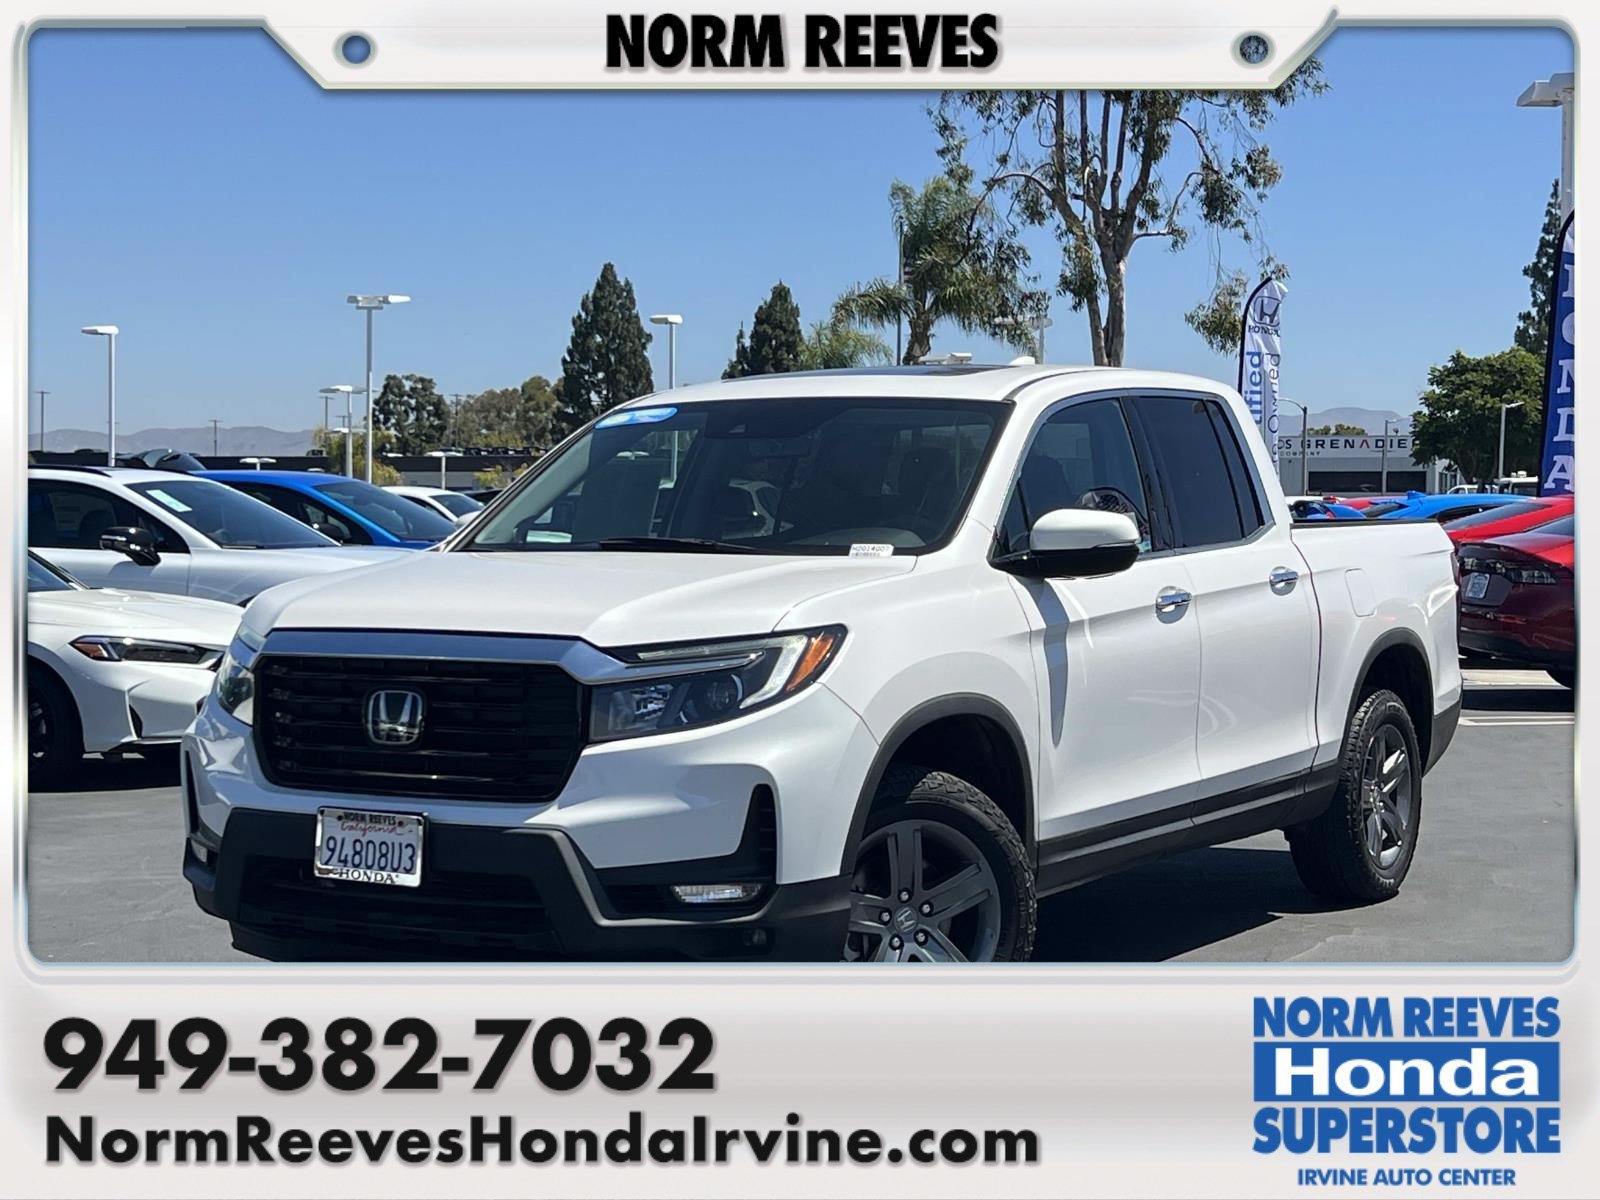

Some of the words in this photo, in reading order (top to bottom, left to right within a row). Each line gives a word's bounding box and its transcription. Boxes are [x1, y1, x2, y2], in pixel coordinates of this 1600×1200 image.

[1300, 438, 1410, 449] GRENADIE
[323, 835, 416, 874] 94808U3
[338, 868, 396, 884] HONDA
